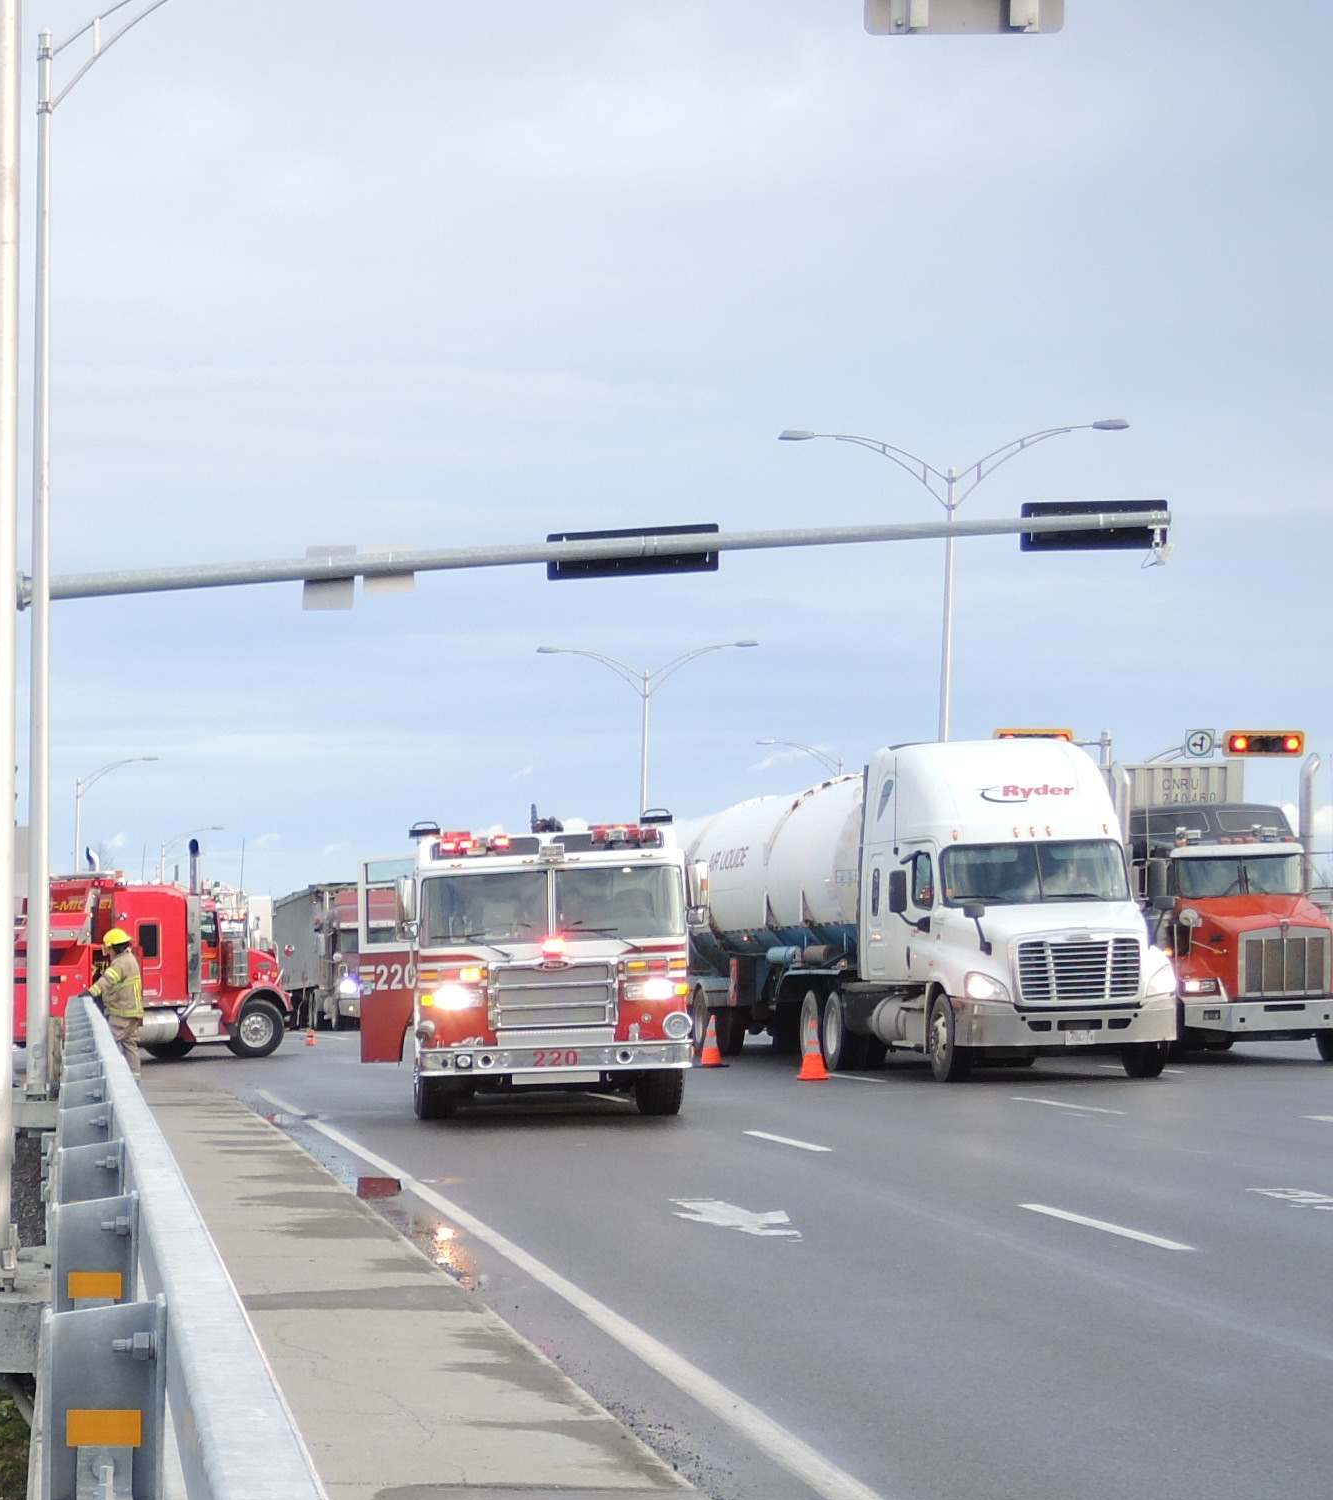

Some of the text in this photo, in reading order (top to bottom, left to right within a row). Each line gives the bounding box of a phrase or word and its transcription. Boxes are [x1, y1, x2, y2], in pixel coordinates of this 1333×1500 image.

[1002, 784, 1074, 799] Ryder
[1162, 779, 1199, 790] CNRU
[376, 964, 416, 990] 220
[533, 1049, 580, 1067] 220
